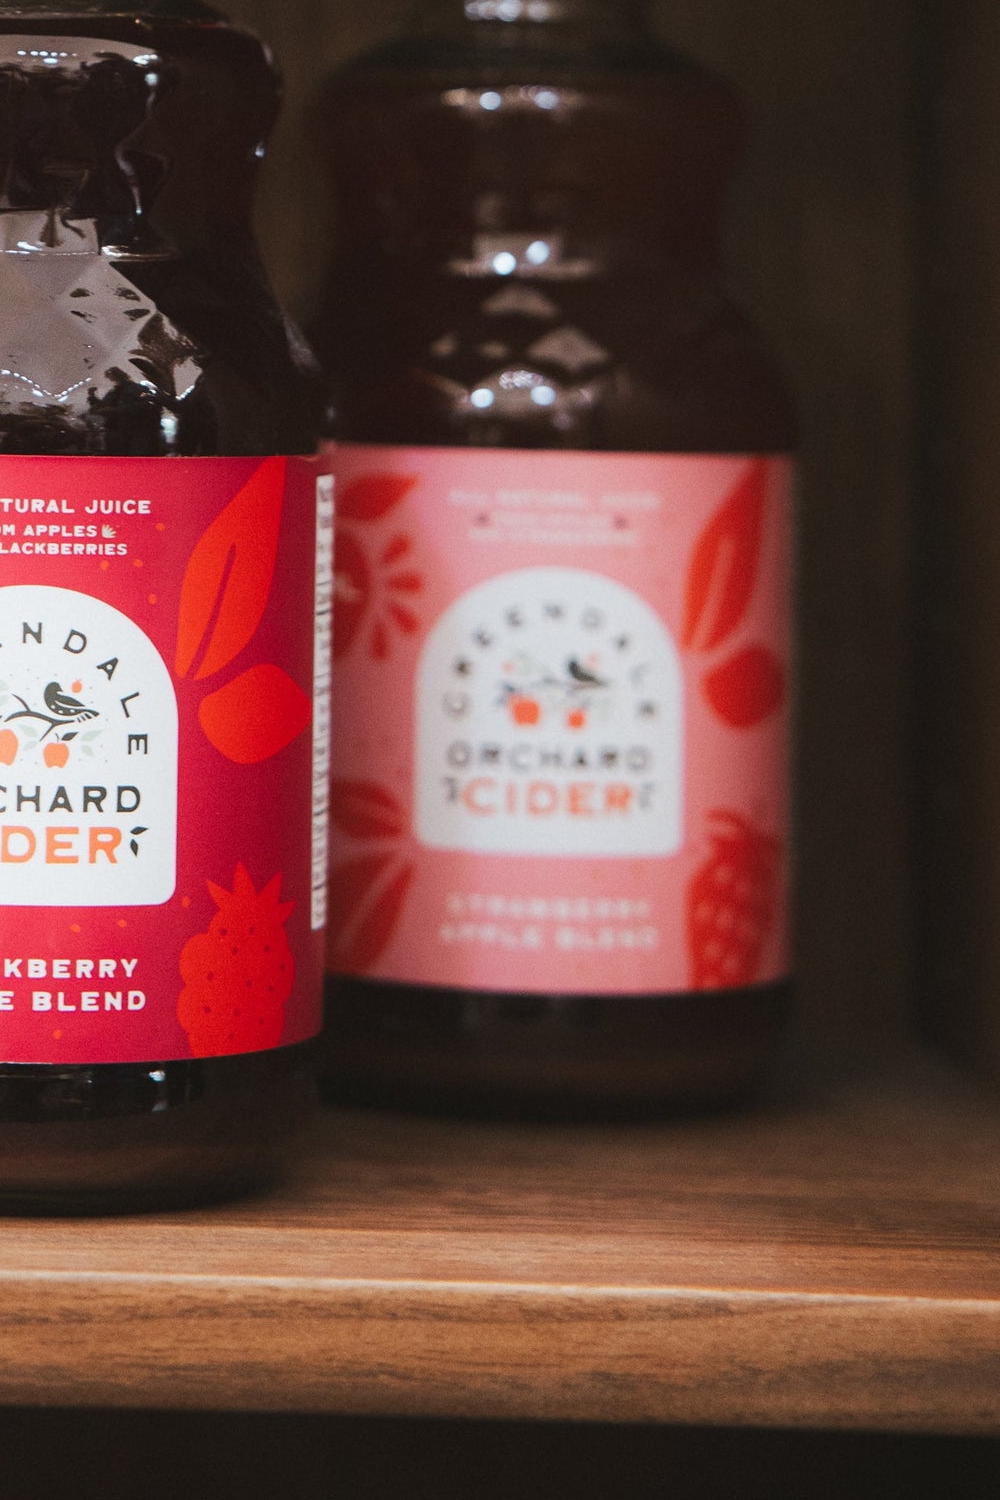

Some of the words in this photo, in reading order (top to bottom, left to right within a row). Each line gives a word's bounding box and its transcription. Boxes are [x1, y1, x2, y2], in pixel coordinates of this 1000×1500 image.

[84, 499, 152, 516] JUICE
[23, 524, 98, 539] APPLES
[461, 777, 634, 818] CIDER
[31, 989, 147, 1012] BLEND
